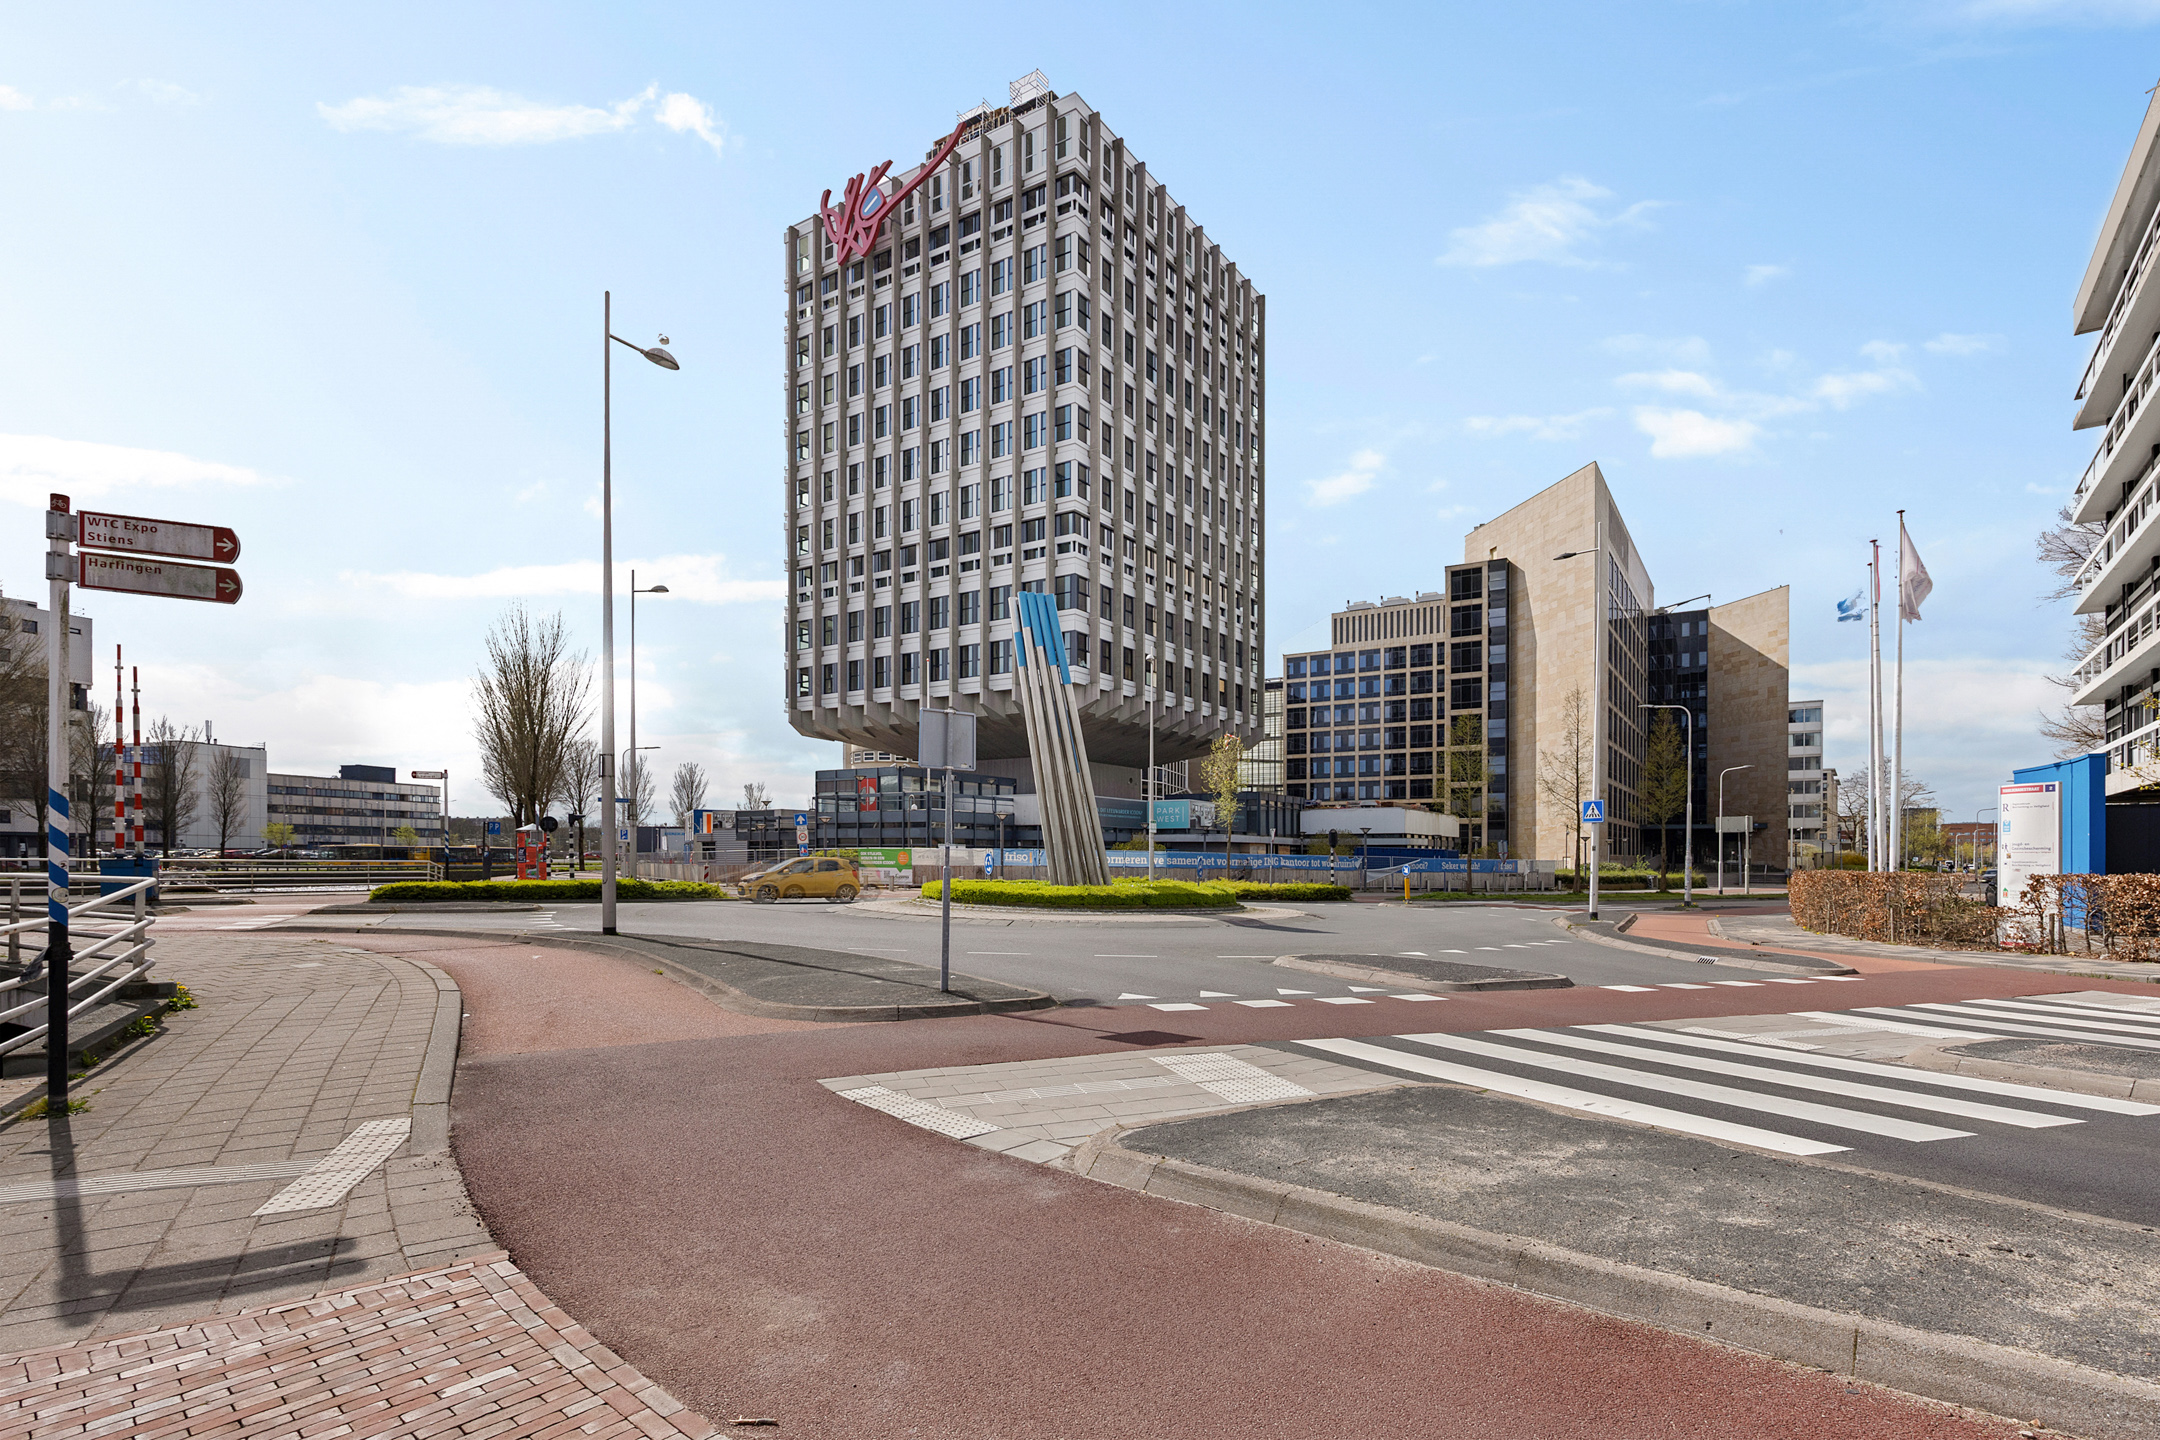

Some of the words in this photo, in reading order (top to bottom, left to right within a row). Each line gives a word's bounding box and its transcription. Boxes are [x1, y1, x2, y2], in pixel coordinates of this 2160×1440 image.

[87, 516, 119, 529] WTC
[124, 521, 158, 534] Expo
[87, 531, 134, 545] Stiens
[88, 557, 162, 575] Harlingen
[1156, 807, 1181, 815] PARK
[1156, 815, 1180, 823] WEST
[1004, 851, 1028, 862] friso
[1166, 857, 1197, 865] samen
[1264, 857, 1279, 866] ING
[1280, 857, 1309, 867] kantoor
[1310, 858, 1321, 867] tot
